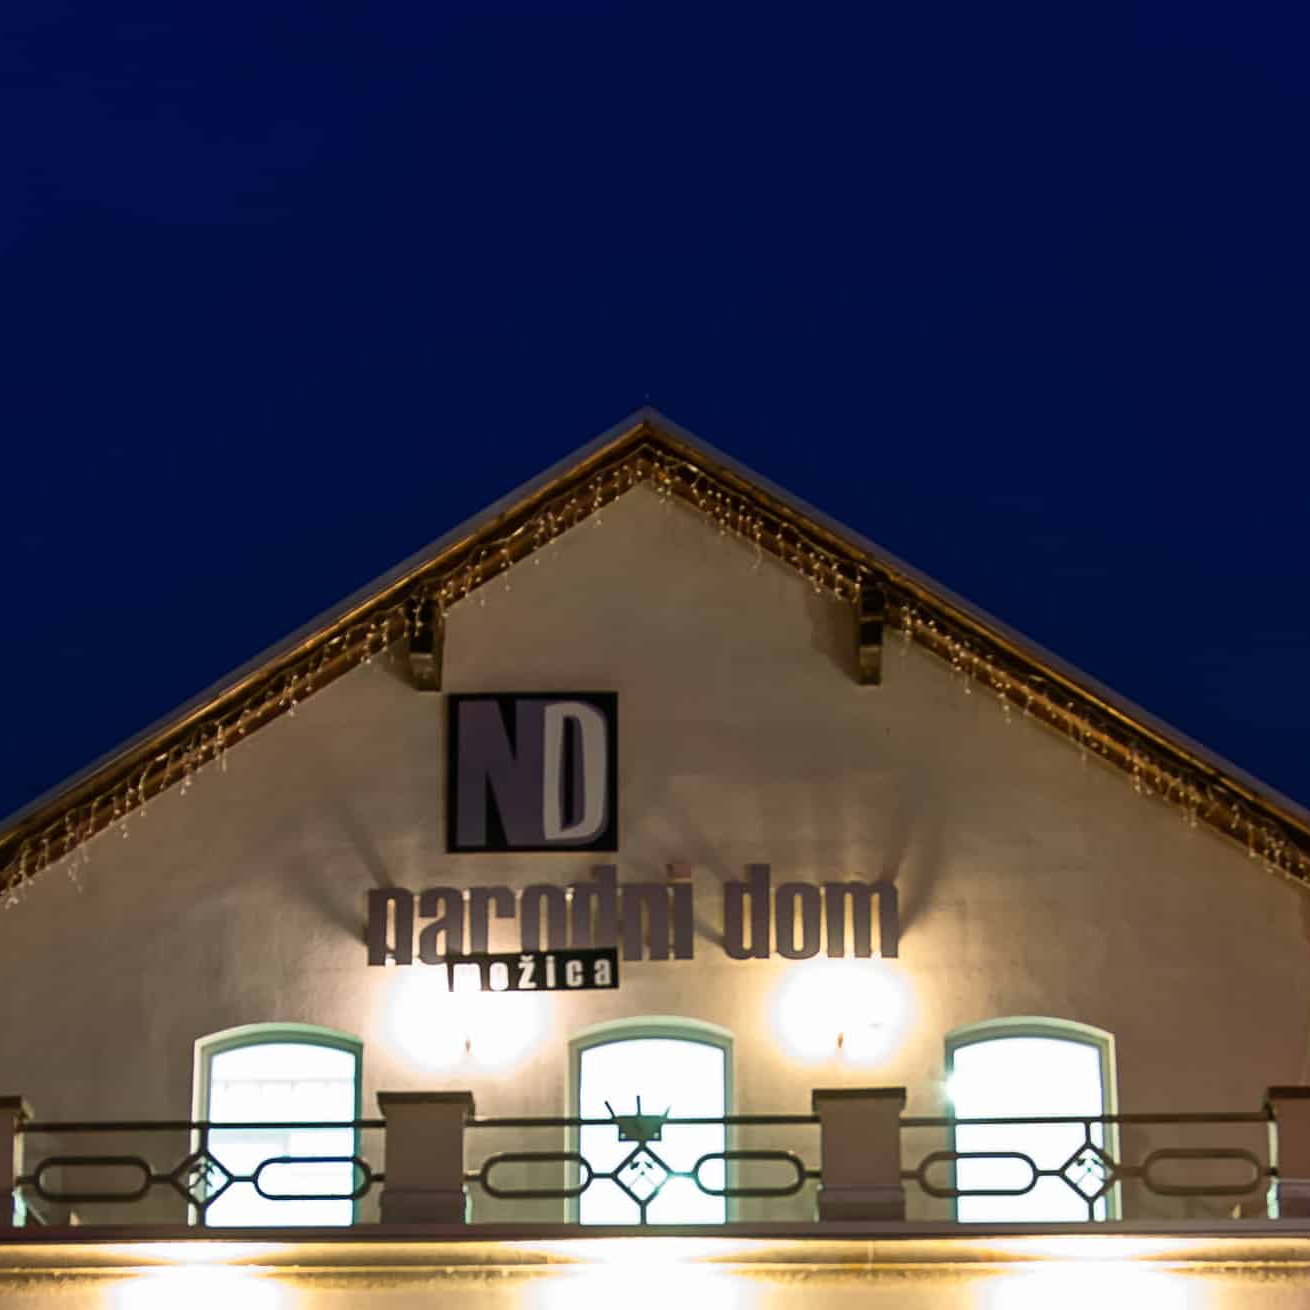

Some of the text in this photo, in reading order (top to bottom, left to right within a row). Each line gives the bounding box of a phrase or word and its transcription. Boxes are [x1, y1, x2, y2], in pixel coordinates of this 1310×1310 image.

[457, 699, 608, 846] ND
[367, 864, 900, 966] narodni dom
